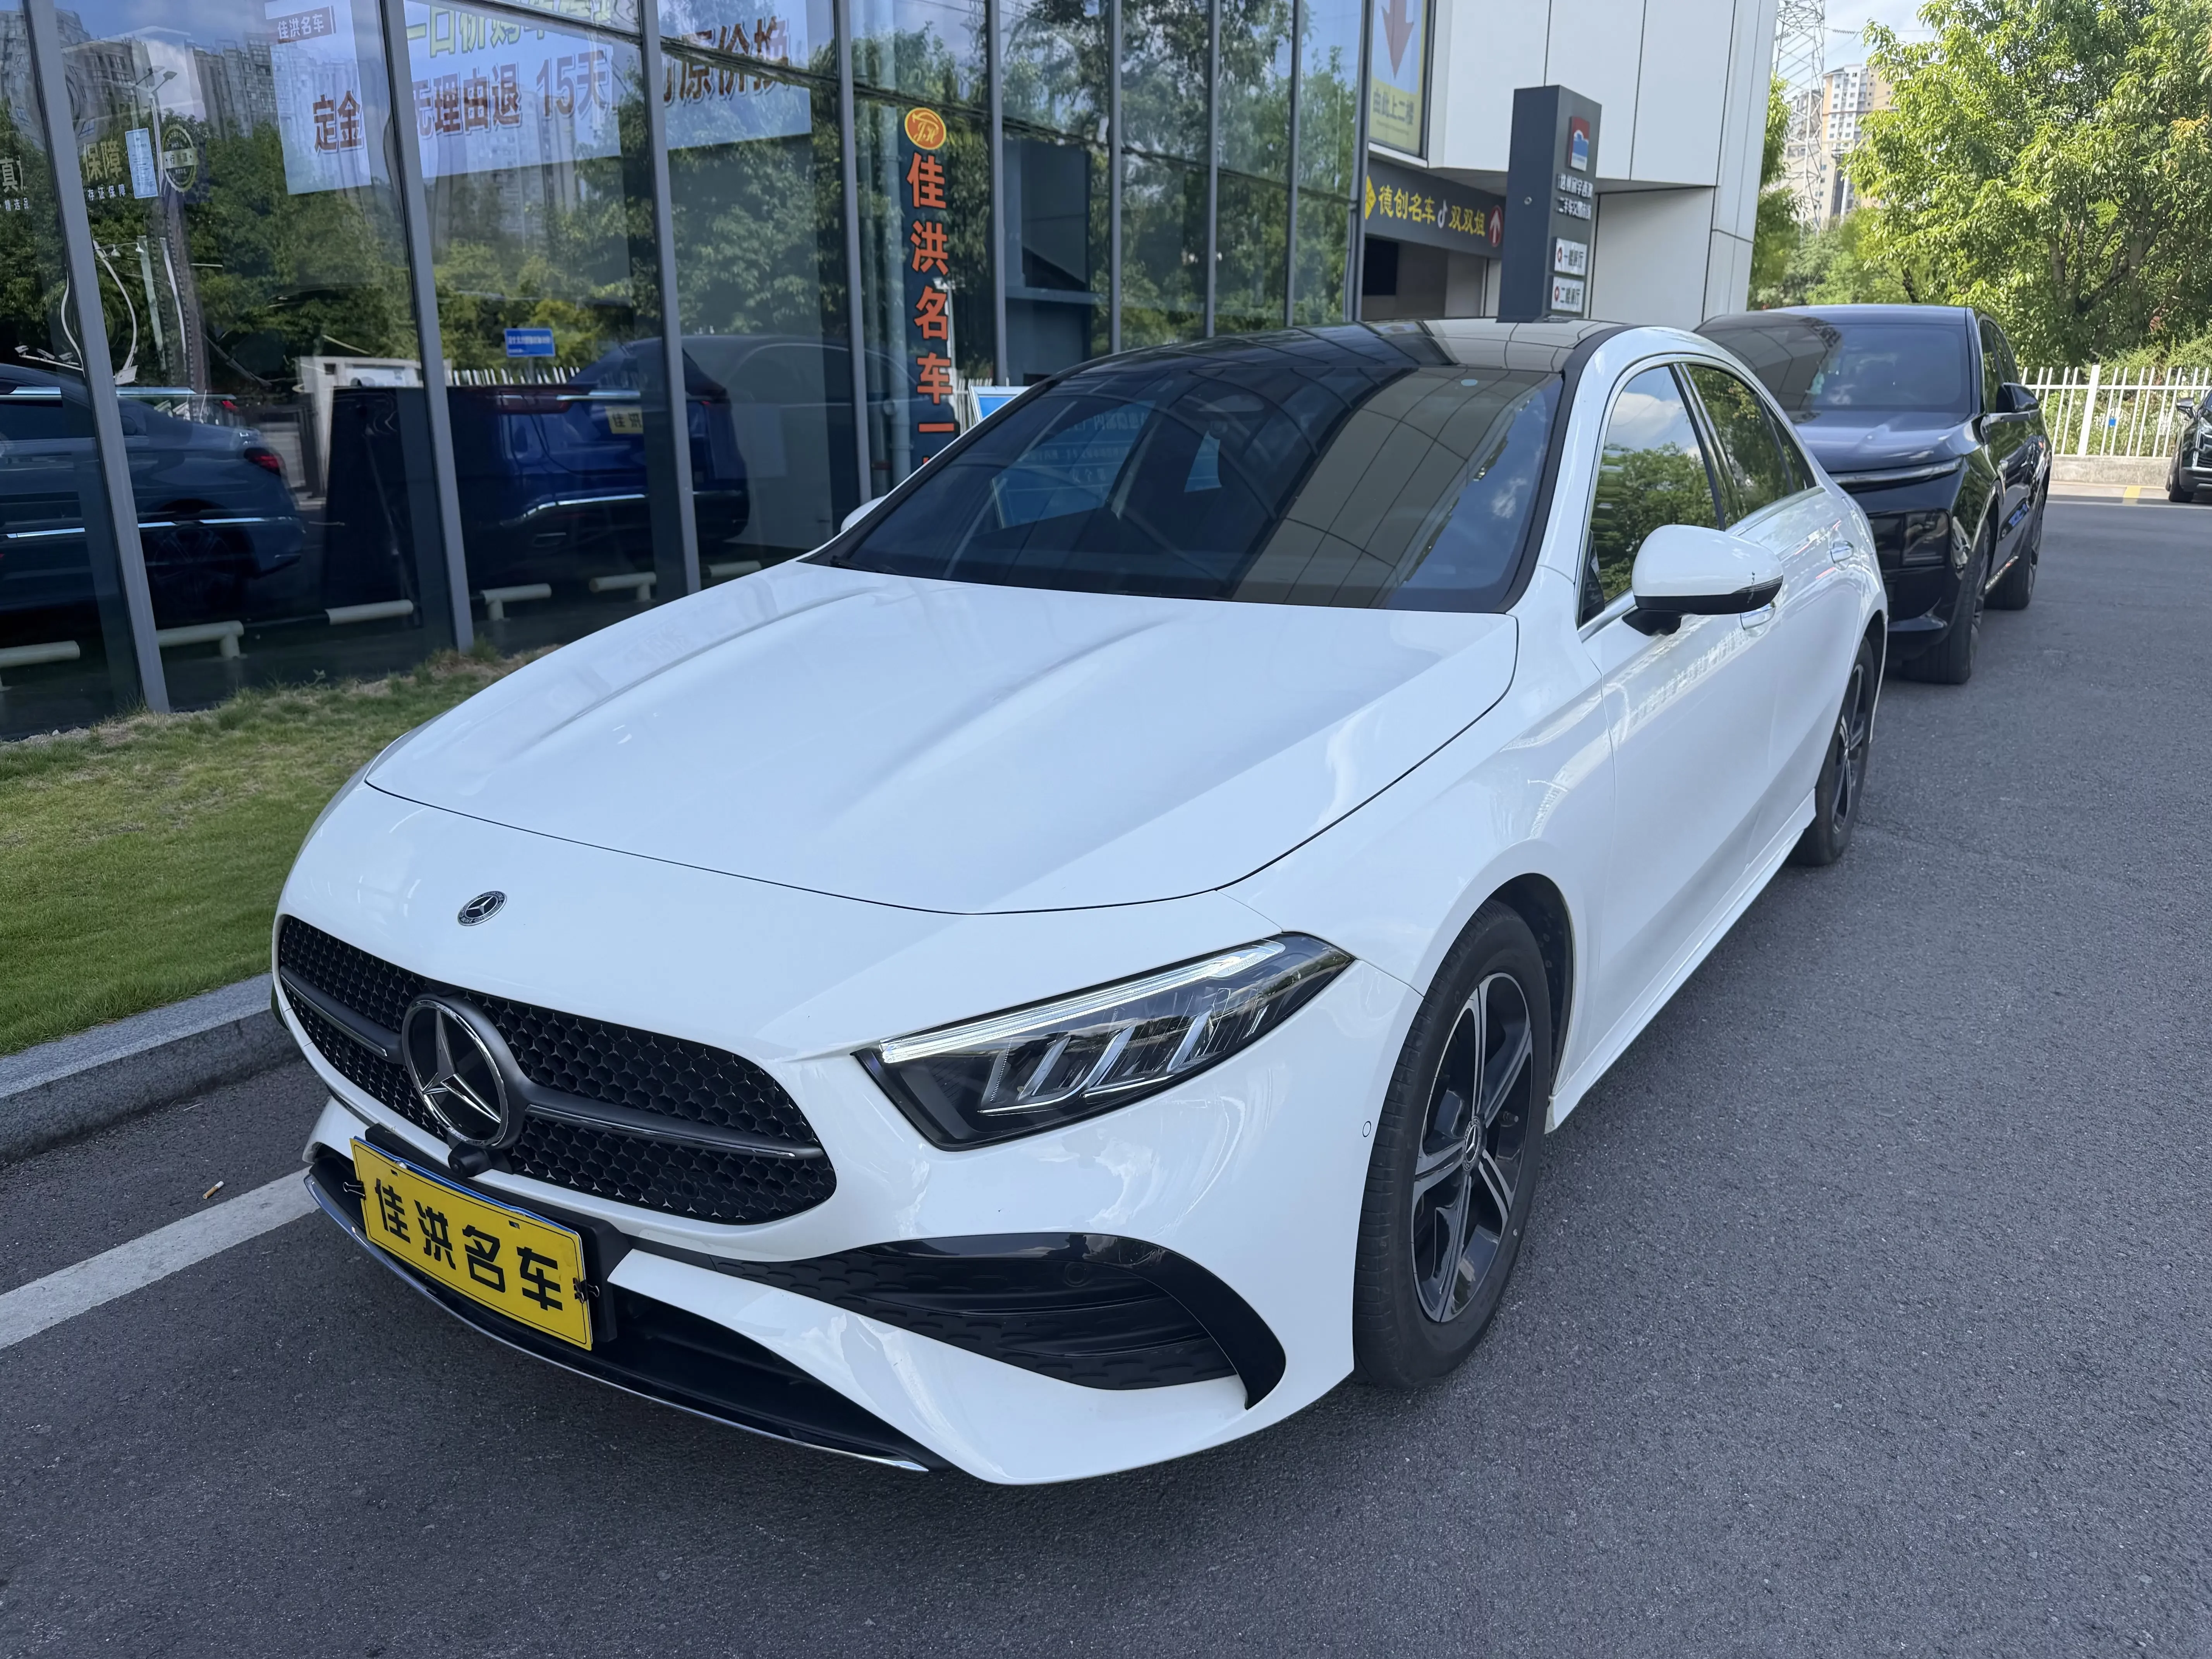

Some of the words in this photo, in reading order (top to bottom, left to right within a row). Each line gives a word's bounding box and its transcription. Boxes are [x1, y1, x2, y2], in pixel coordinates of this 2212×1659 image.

[278, 14, 324, 39] 佳洪名车
[407, 5, 544, 58] 一口价购
[313, 90, 361, 153] 定金
[537, 50, 607, 116] 15天
[0, 155, 23, 193] 真
[83, 139, 123, 182] 保障
[1379, 184, 1436, 224] 德创名车
[1448, 205, 1486, 237] 双双姐
[906, 152, 954, 464] 佳洪名车一
[375, 1178, 563, 1311] 佳洪名车
